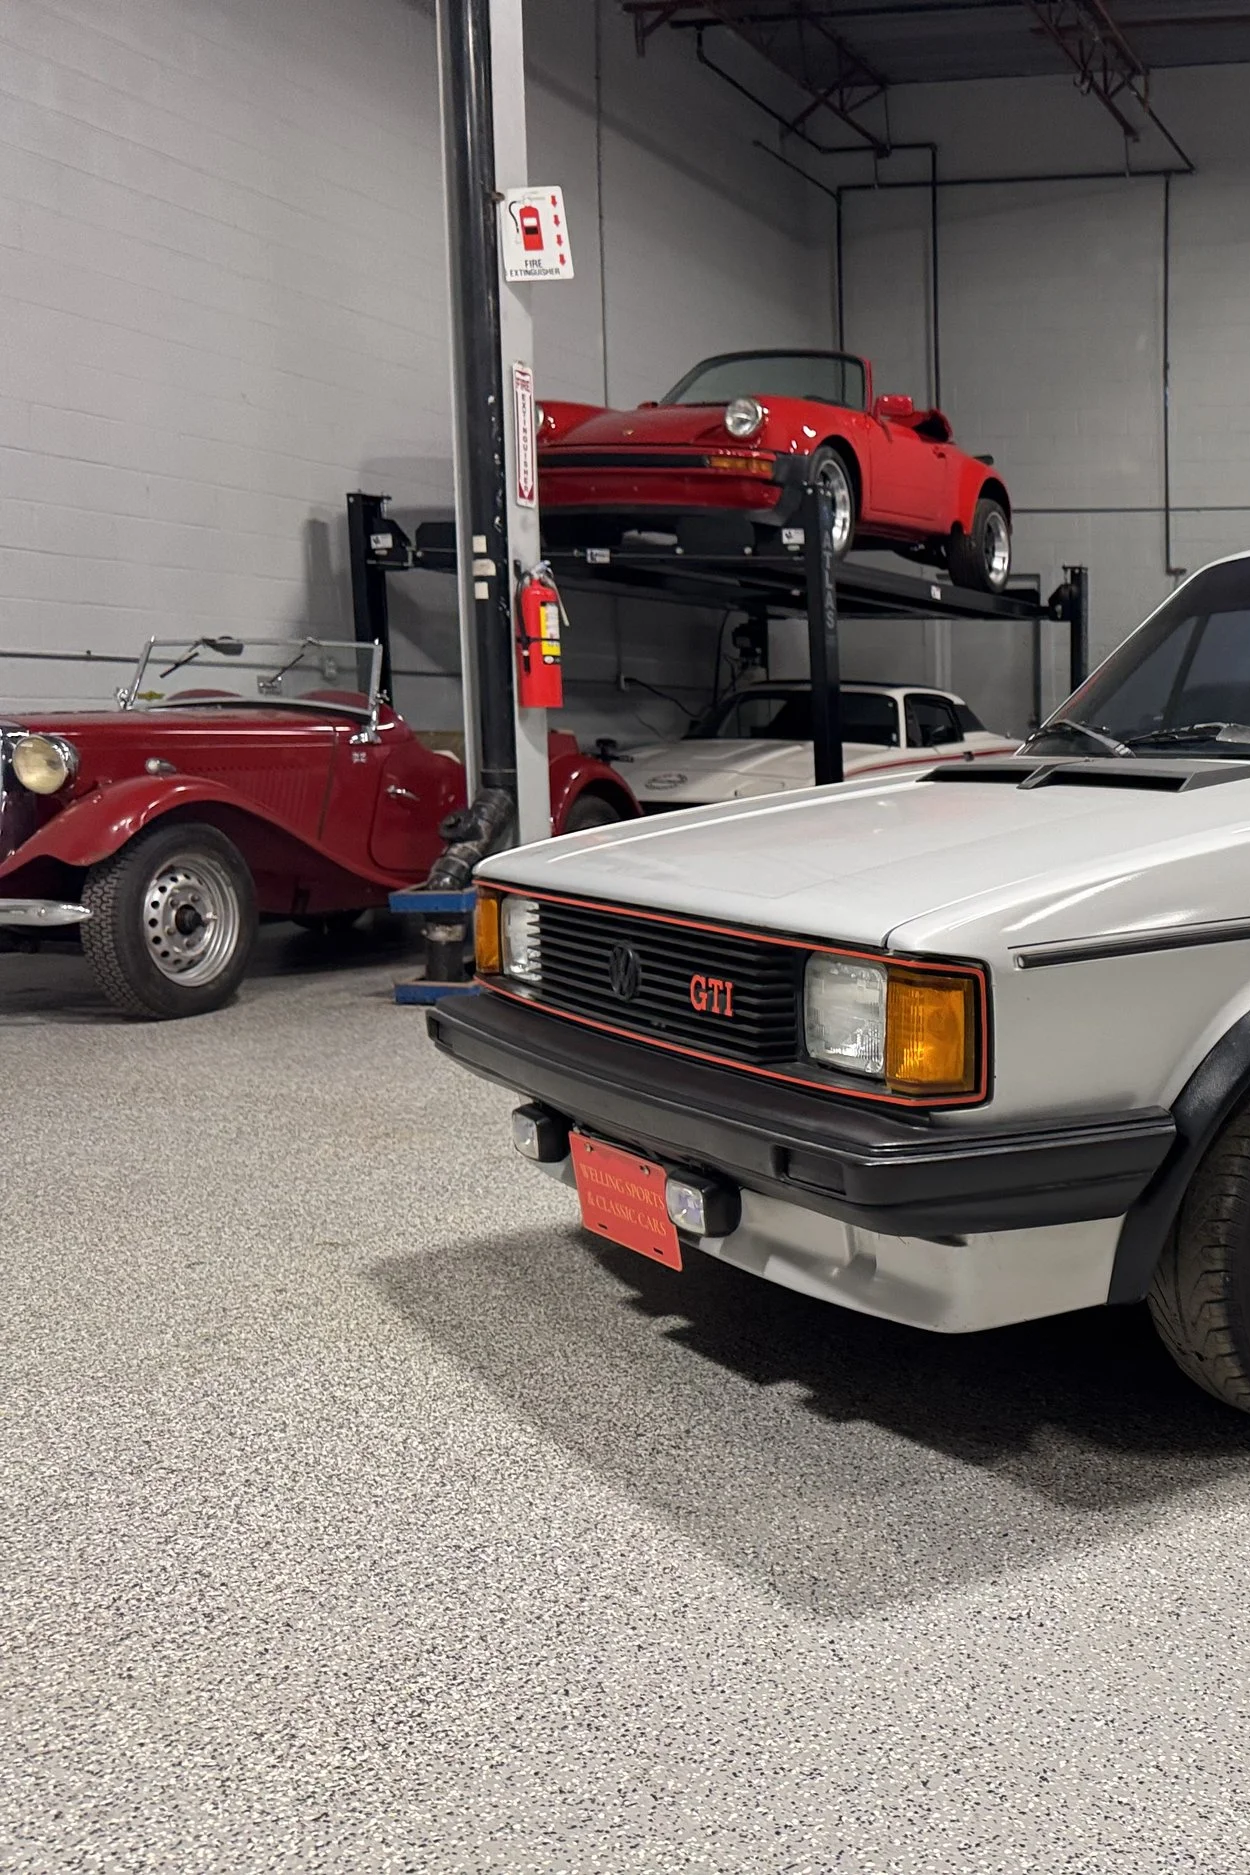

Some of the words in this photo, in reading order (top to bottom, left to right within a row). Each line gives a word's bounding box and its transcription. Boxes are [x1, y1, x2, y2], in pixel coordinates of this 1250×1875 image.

[510, 268, 560, 277] EXTINGUISHER
[524, 259, 542, 268] FIRE
[521, 393, 529, 492] EXTINGUISHER
[822, 531, 835, 628] ATLAS
[690, 973, 734, 1017] GTI
[586, 1191, 597, 1206] &
[597, 1195, 637, 1224] CLASSIC
[638, 1213, 667, 1236] CARS
[625, 1180, 665, 1209] SPORTS
